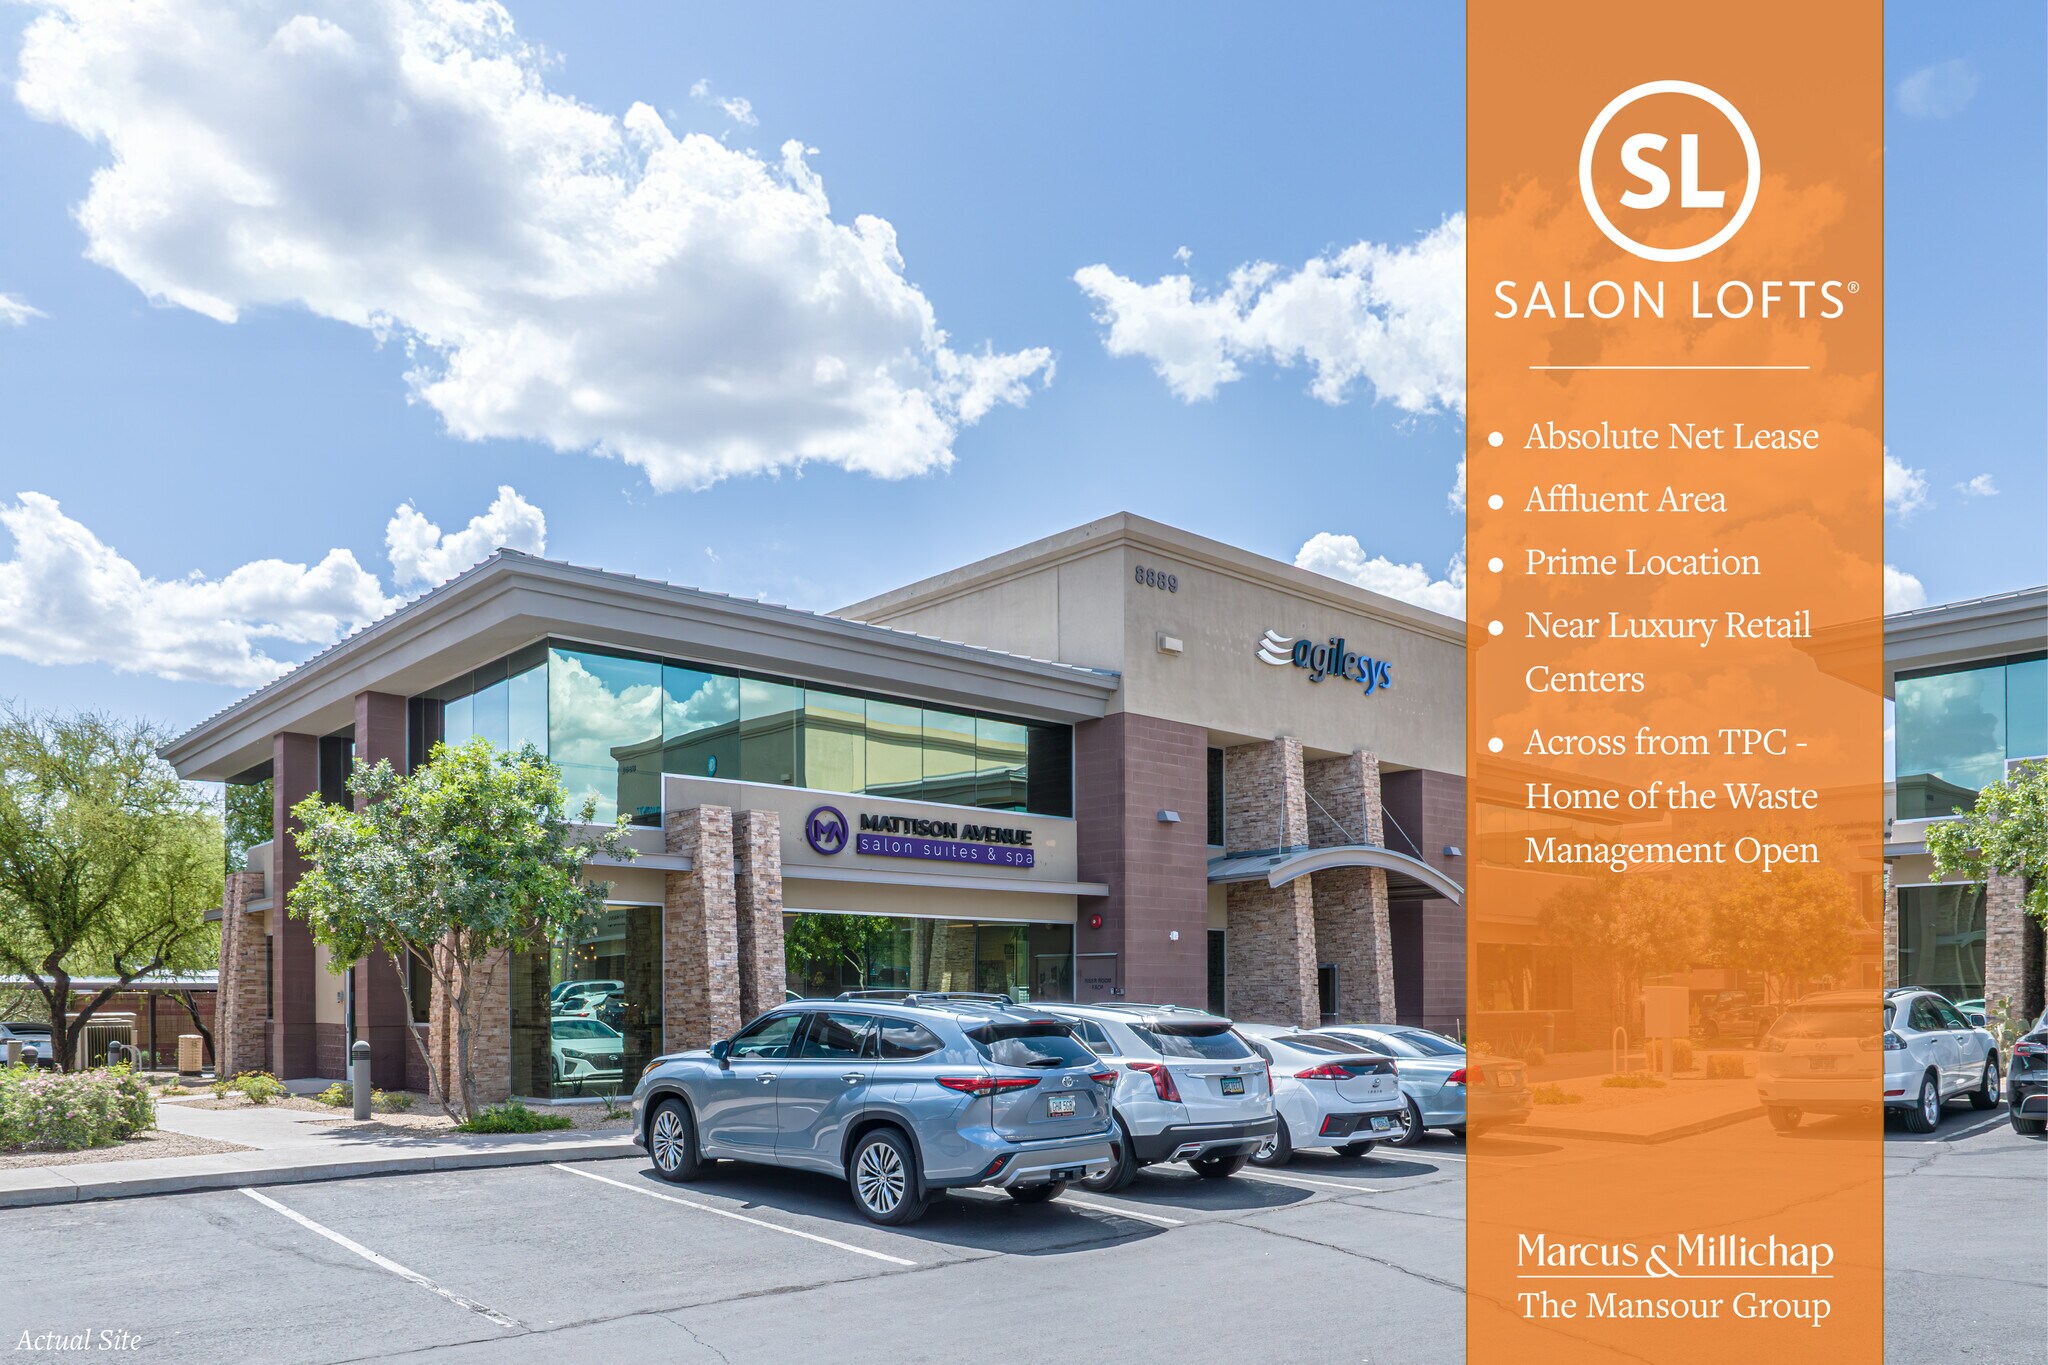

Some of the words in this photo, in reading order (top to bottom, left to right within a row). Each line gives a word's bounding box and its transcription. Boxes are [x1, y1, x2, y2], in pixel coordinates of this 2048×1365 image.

[1135, 565, 1178, 593] 8889
[1291, 637, 1392, 696] agilesys
[860, 813, 957, 839] MATTISON
[961, 824, 1032, 846] AVENUE
[861, 838, 912, 854] salon
[923, 844, 978, 860] suites
[987, 847, 996, 861] &
[1006, 851, 1033, 866] spa
